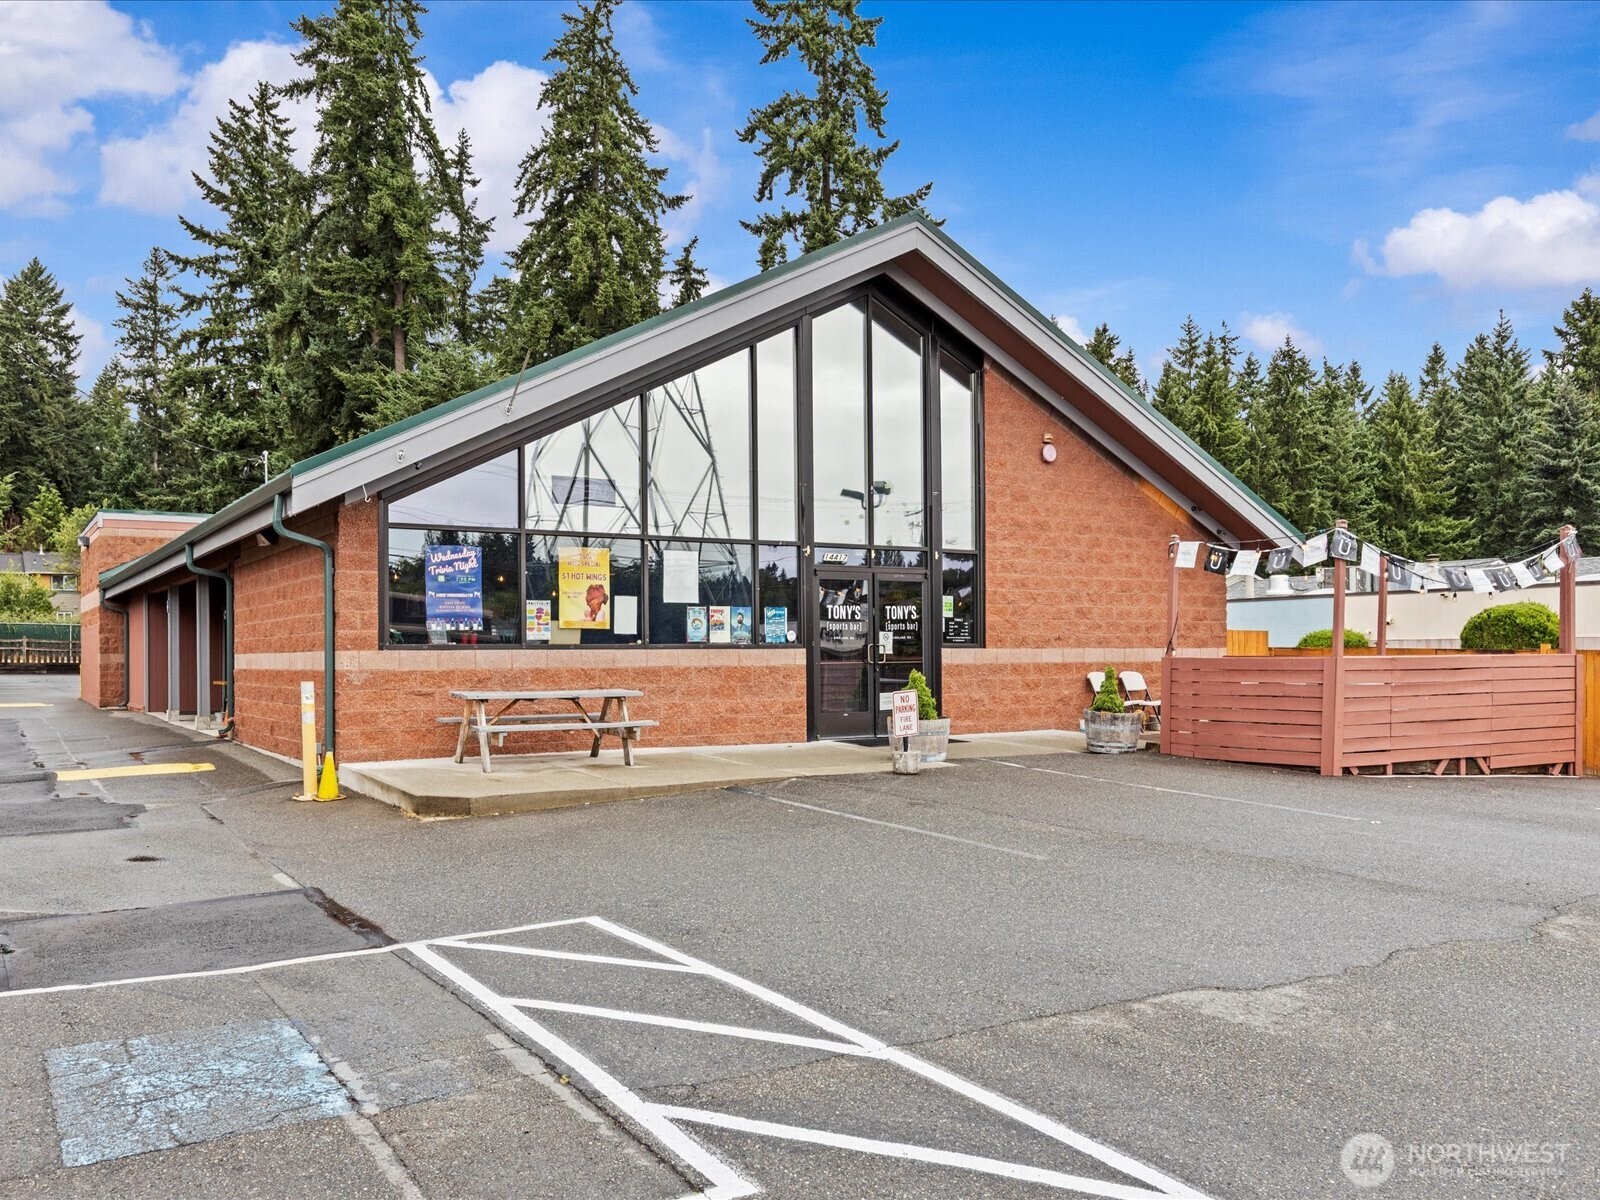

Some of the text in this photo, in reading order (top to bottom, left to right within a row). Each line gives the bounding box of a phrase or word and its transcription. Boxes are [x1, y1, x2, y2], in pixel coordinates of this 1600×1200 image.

[431, 548, 476, 562] Wednesday
[1273, 553, 1286, 569] Ü
[428, 558, 478, 575] Trivia Night
[586, 573, 607, 581] WINGS
[827, 605, 861, 620] TONY'S
[885, 605, 917, 620] TONY'S
[849, 622, 862, 632] bar]
[906, 622, 918, 631] bar]
[900, 695, 909, 703] NO
[895, 704, 916, 713] PARKING
